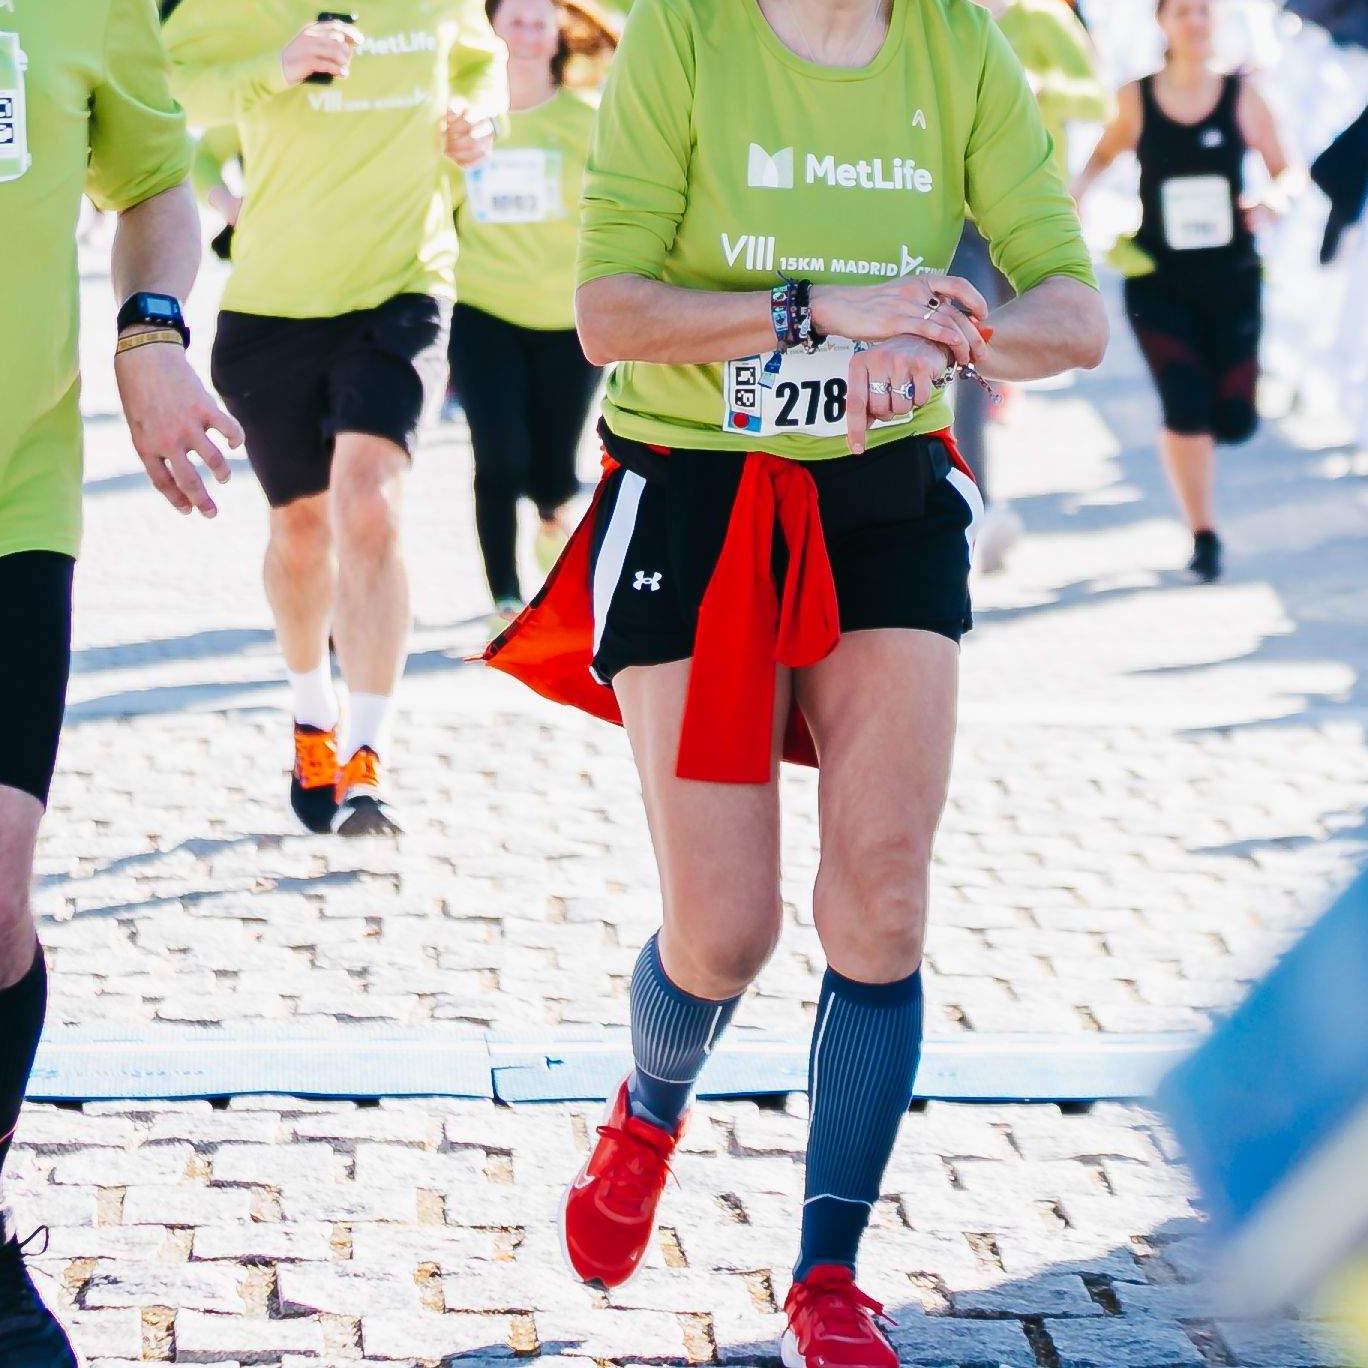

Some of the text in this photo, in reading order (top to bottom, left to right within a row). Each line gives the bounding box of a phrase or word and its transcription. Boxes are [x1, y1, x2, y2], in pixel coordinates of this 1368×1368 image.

[805, 152, 934, 193] MetLife
[720, 233, 776, 271] VIII
[779, 257, 825, 272] 15KM
[831, 259, 898, 277] MADRID
[774, 377, 848, 428] 278
